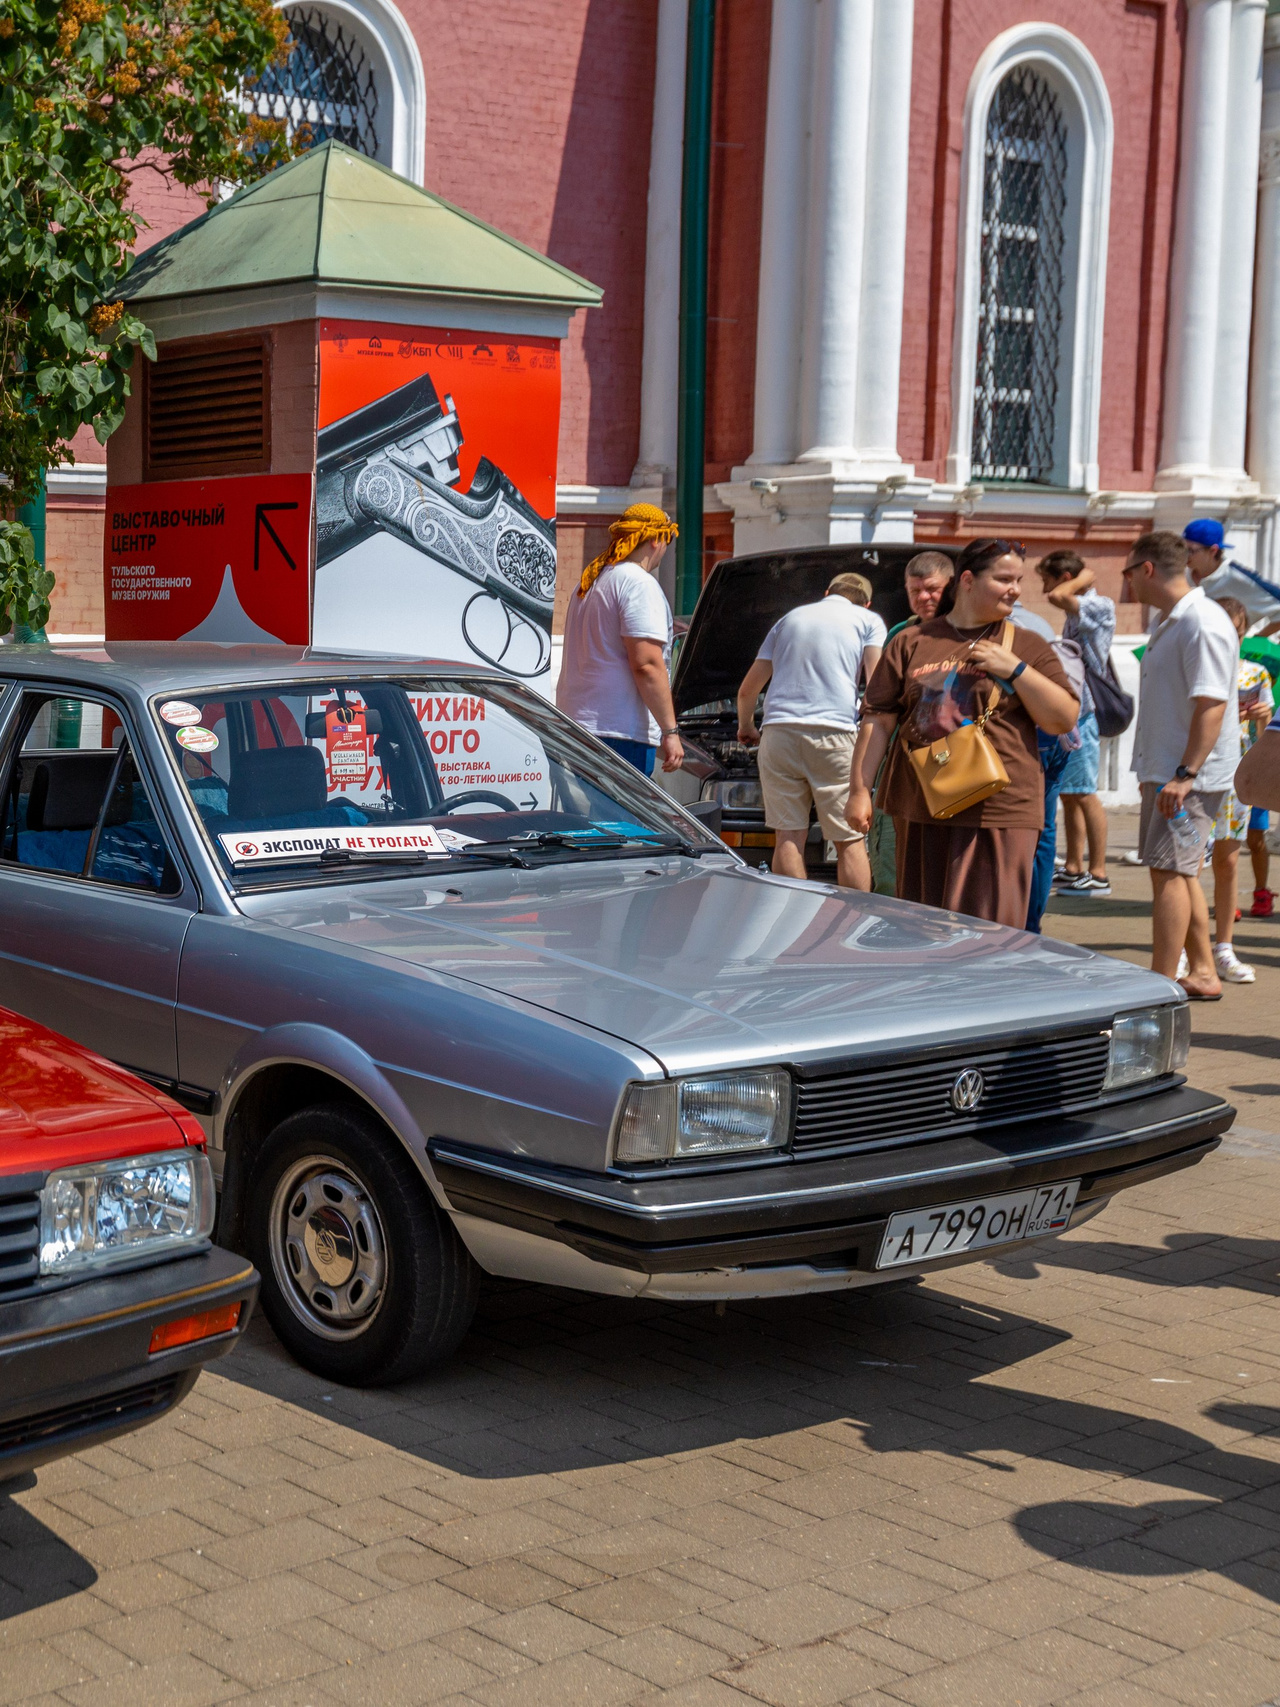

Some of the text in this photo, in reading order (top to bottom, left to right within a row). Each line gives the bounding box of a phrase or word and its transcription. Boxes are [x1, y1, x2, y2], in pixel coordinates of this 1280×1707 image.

[412, 346, 432, 357] КБП
[112, 503, 225, 530] ВЫСТАВОЧНЫЙ
[111, 534, 156, 555] ЦЕНТР
[111, 565, 156, 576] ТУЛЬСКОГО
[111, 577, 192, 590] ГОСУДАРСТВЕННОГО
[111, 590, 170, 600] МУЗЕЯ ОРУЖИЯ
[440, 761, 491, 772] ВЫСТАВКА
[524, 754, 538, 767] 6+
[332, 775, 366, 783] УЧАСТНИК
[447, 774, 496, 785] 80-ЛЕТИЮ
[497, 773, 522, 784] ЦКИБ
[523, 772, 542, 781] СОО
[263, 835, 433, 853] ЭКСПОНАТ НЕ ТРОГАТЬ!
[1035, 1186, 1069, 1220] 71
[1027, 1218, 1051, 1232] RUS
